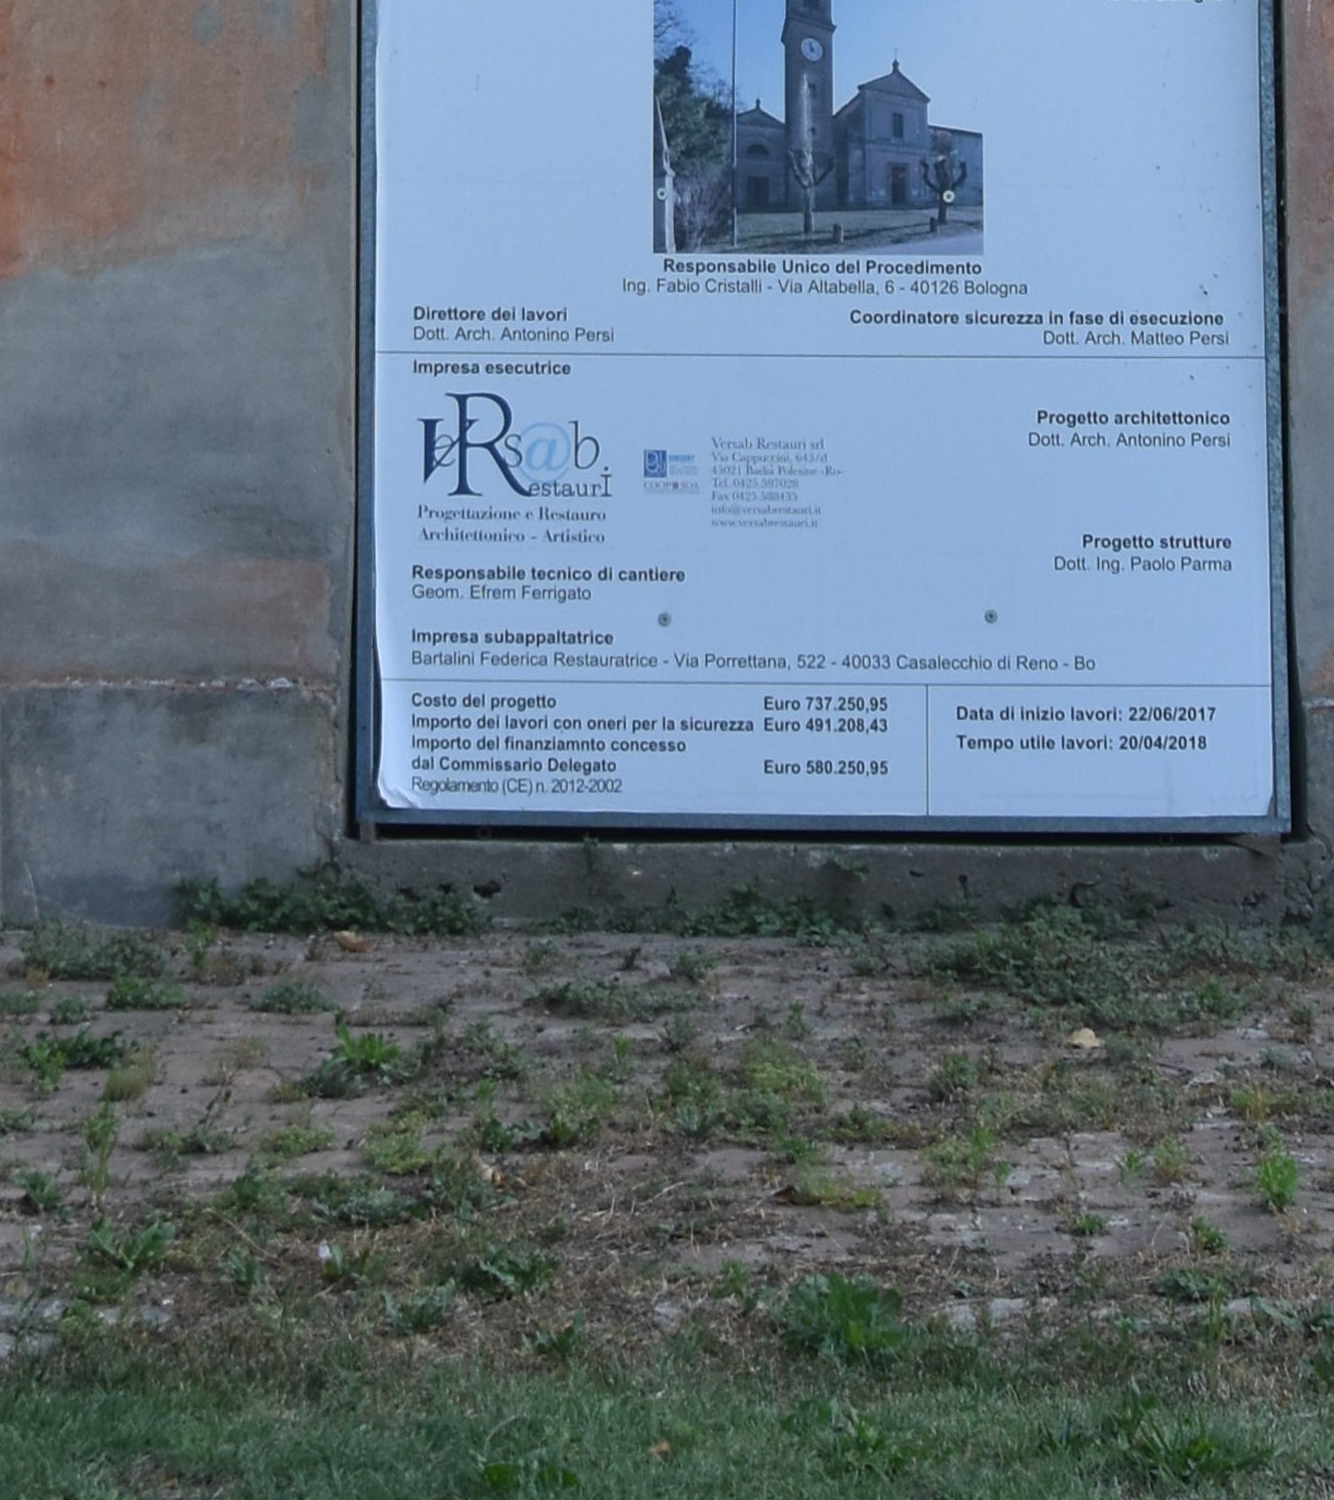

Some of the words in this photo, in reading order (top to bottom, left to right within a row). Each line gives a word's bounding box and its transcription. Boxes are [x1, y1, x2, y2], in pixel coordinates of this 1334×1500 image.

[663, 258, 777, 276] Responsabile
[782, 259, 830, 274] Unico
[835, 259, 860, 274] del
[866, 260, 982, 275] Procedimento
[623, 278, 650, 296] Ing.
[656, 278, 700, 293] Fabio
[704, 277, 762, 293] Cristalli
[777, 278, 803, 294] Via
[807, 279, 880, 297] Altabella,
[884, 279, 895, 295] 6
[909, 279, 959, 295] 40126
[964, 279, 1028, 299] Bologna
[413, 306, 486, 321] Direttore
[491, 307, 516, 322] dei
[521, 307, 567, 322] lavori
[850, 309, 959, 324] Coordinatore
[965, 309, 1043, 325] sicurezza
[1049, 310, 1063, 325] in
[1069, 311, 1104, 325] fase
[1109, 311, 1124, 326] di
[1129, 310, 1223, 326] esecuzione
[413, 325, 450, 341] Dott.
[454, 326, 495, 341] Arch.
[500, 326, 569, 342] Antonino
[575, 327, 614, 342] Persi
[1043, 330, 1079, 345] Dott.
[1084, 330, 1125, 345] Arch.
[1131, 330, 1185, 345] Matteo
[1189, 330, 1229, 345] Persi
[413, 359, 480, 377] Impresa
[485, 360, 571, 375] esecutrice
[1037, 410, 1109, 428] Progetto
[1114, 410, 1230, 426] architettonico
[1083, 534, 1154, 553] Progetto
[1159, 535, 1232, 550] strutture
[412, 565, 526, 583] Responsabile
[531, 566, 592, 581] tecnico
[597, 566, 613, 581] di
[618, 567, 685, 582] cantiere
[412, 629, 479, 647] Impresa
[484, 629, 613, 648] subappaltatrice
[411, 650, 475, 666] Bartalini
[480, 651, 548, 667] Federica
[553, 652, 658, 668] Restauratrice
[674, 653, 699, 668] Via
[705, 653, 791, 670] Porrettana,
[797, 654, 826, 669] 522
[841, 654, 891, 670] 40033
[896, 655, 992, 670] Casalecchio
[997, 655, 1011, 670] di
[1016, 655, 1058, 671] Reno
[1074, 655, 1095, 671] Bo
[411, 692, 457, 708] Costo
[462, 693, 485, 708] del
[491, 695, 556, 712] progetto
[764, 696, 801, 711] Euro
[805, 696, 888, 714] 737.250,95
[957, 706, 994, 721] Data
[999, 706, 1015, 721] di
[1020, 706, 1065, 721] inizio
[1071, 706, 1122, 721] lavori:
[1129, 706, 1216, 722] 22/06/2017
[412, 713, 472, 732] Importo
[476, 714, 500, 729] dei
[505, 714, 548, 730] lavori
[553, 718, 582, 733] con
[587, 716, 626, 731] oneri
[632, 719, 656, 734] per
[662, 716, 675, 731] la
[680, 717, 754, 732] sicurezza
[764, 717, 801, 732] Euro
[805, 717, 888, 734] 491.208,43
[412, 734, 472, 753] Importo
[476, 735, 500, 751] del
[504, 736, 606, 751] finanziamnto
[610, 740, 686, 752] concesso
[956, 735, 1014, 753] Tempo
[1020, 734, 1056, 750] utile
[1061, 735, 1112, 750] lavori:
[1119, 735, 1207, 750] 20/04/2018
[411, 755, 434, 770] dal
[439, 756, 543, 772] Commissario
[548, 757, 616, 776] Delegato
[764, 759, 801, 774] Euro
[806, 759, 888, 776] 580.250,95
